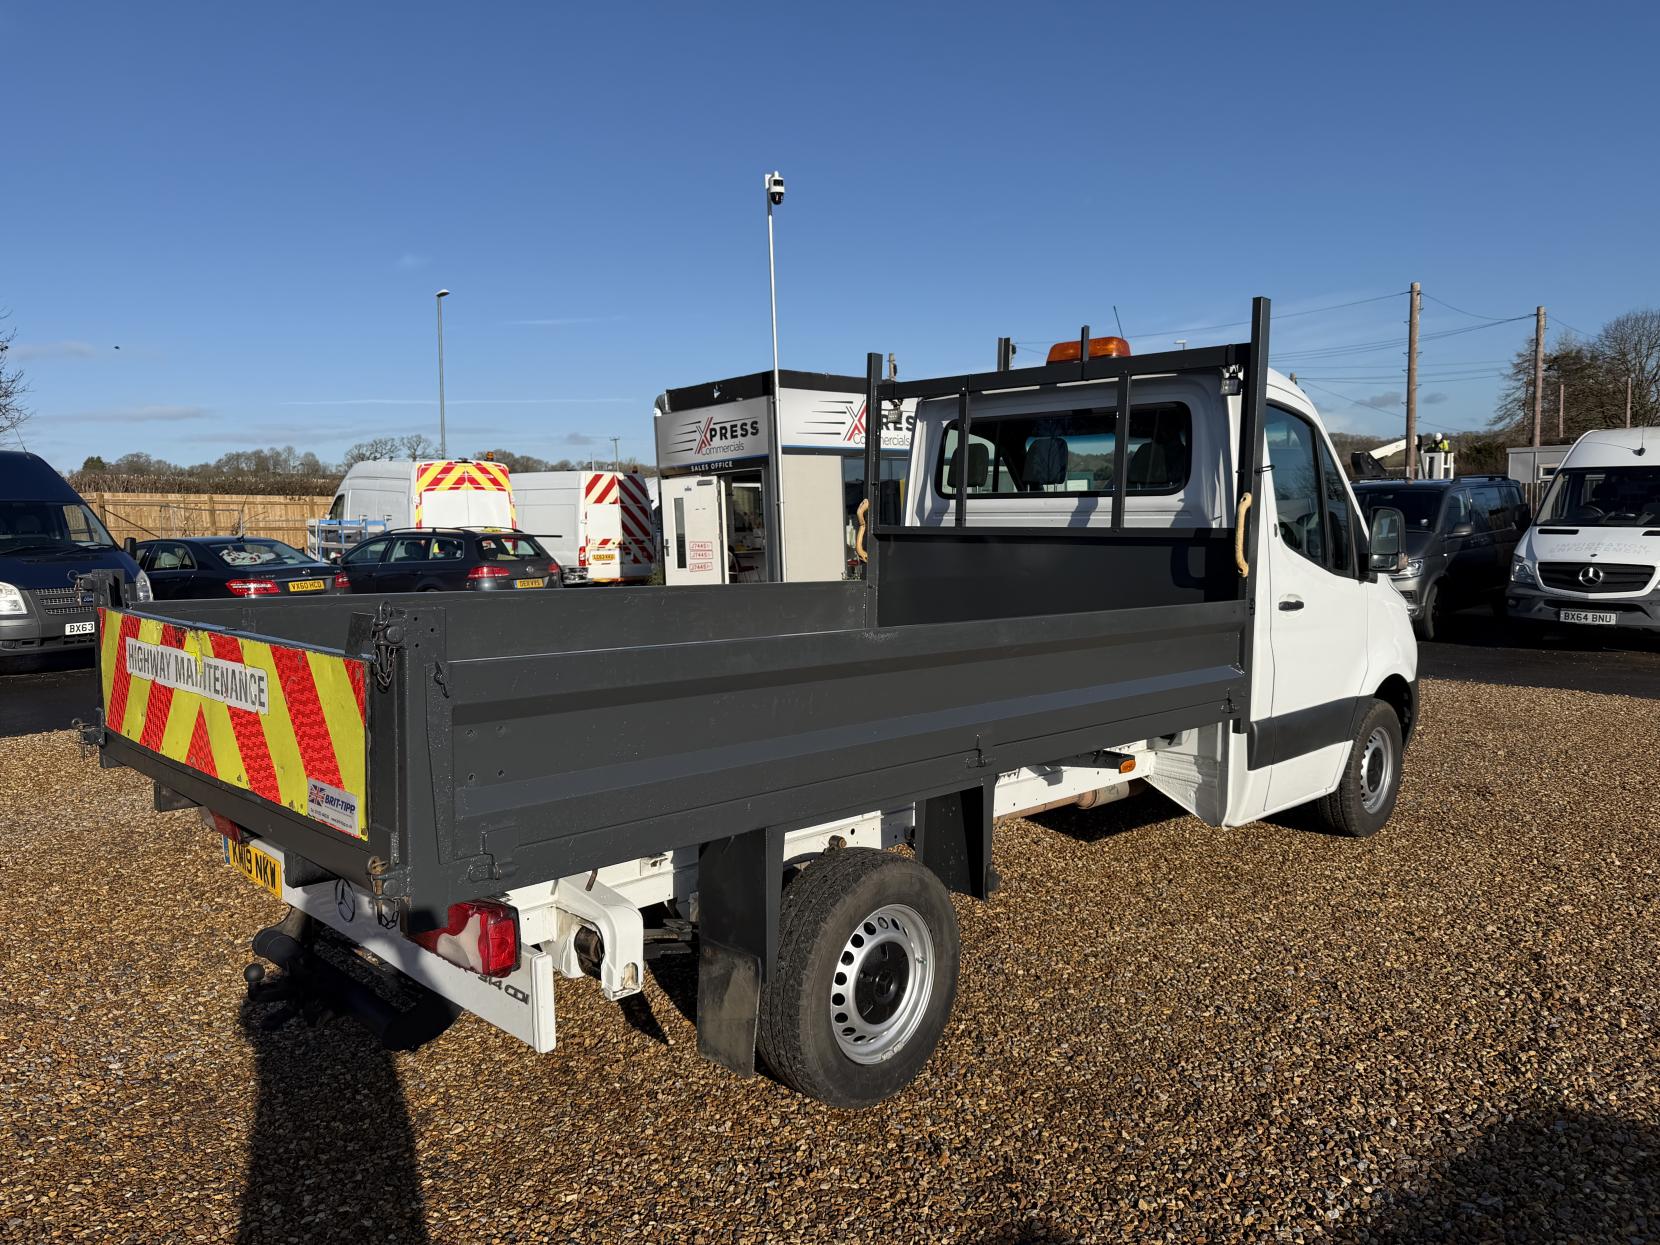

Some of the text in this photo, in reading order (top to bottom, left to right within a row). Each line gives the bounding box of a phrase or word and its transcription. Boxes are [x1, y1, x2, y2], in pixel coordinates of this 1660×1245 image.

[695, 416, 760, 454] XPRESS
[701, 441, 745, 456] Commercials
[690, 460, 733, 472] SALES OFFICE
[1564, 611, 1612, 623] BX64 BNU
[69, 622, 94, 633] BX63
[128, 643, 172, 681] HIGHWAY
[324, 794, 356, 813] BRIT-TIPP
[254, 852, 276, 890] NKW
[504, 984, 530, 1005] CDI
